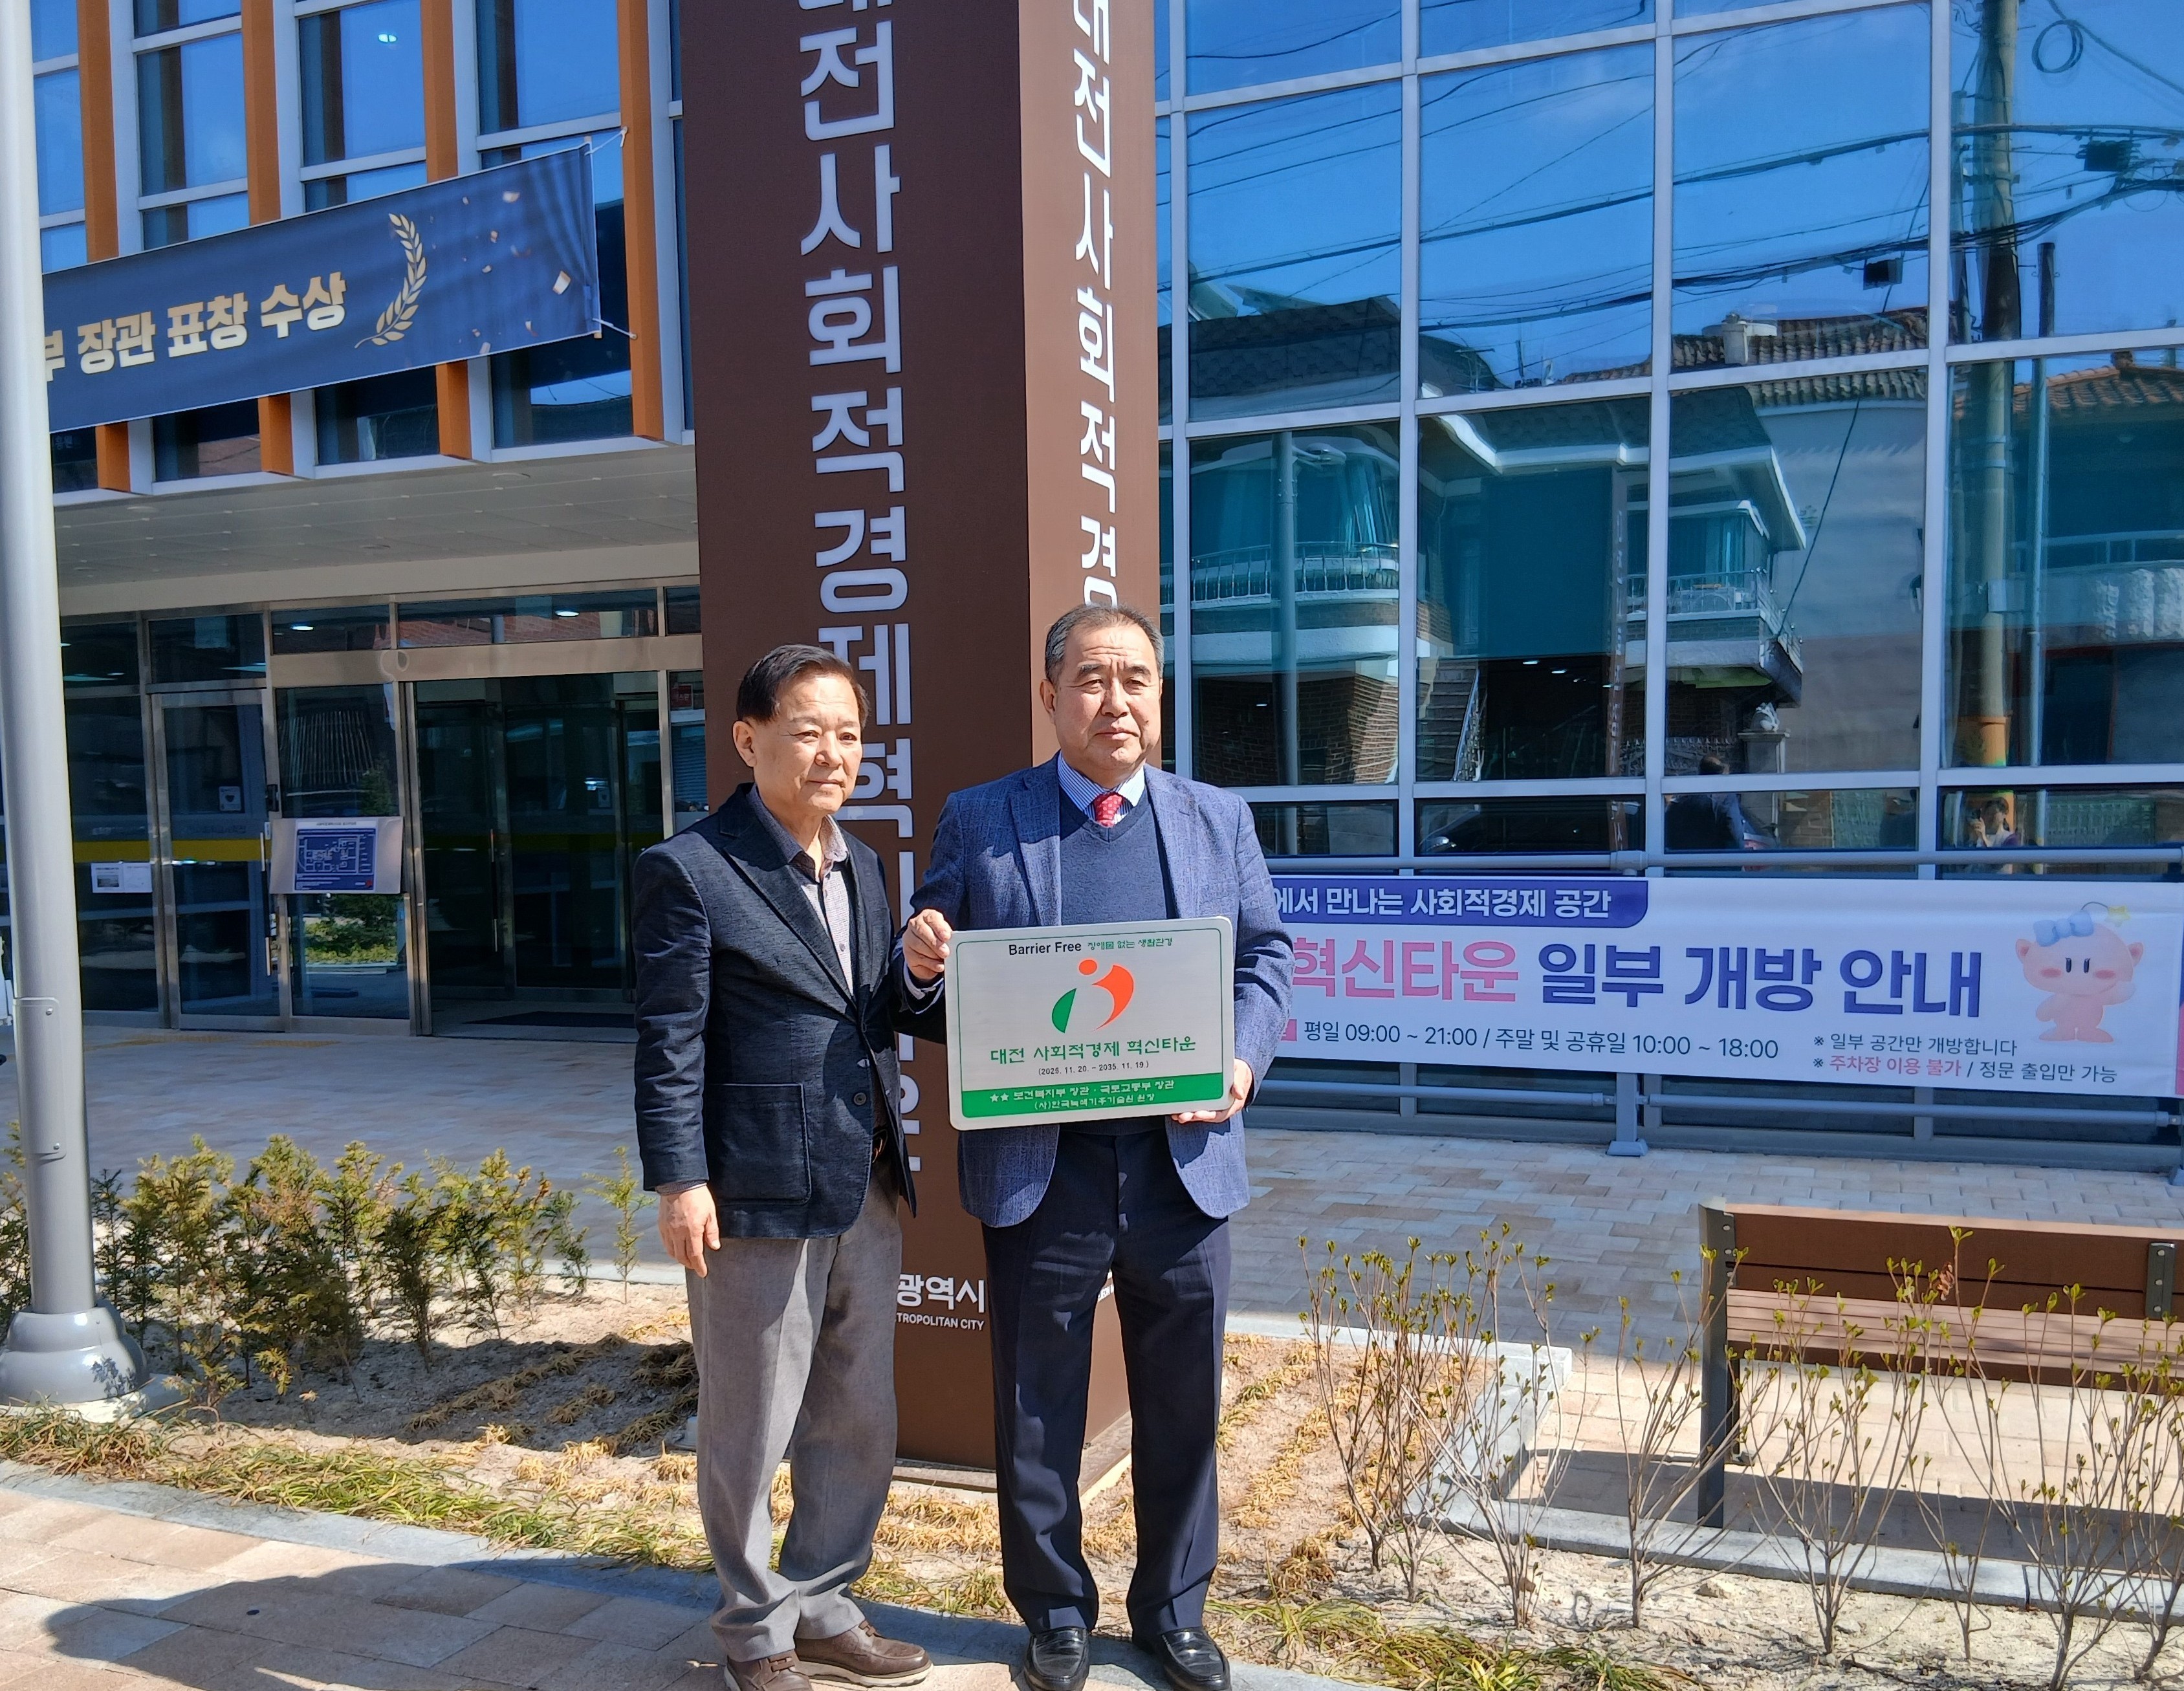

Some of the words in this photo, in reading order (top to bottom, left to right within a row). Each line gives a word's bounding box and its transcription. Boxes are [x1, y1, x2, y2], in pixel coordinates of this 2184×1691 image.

[78, 311, 156, 375] 장관
[167, 291, 248, 358] 표창
[260, 271, 347, 338] 수상
[1274, 887, 1318, 914] 에서
[1326, 888, 1403, 916] 만나는
[1411, 888, 1546, 917] 사회적경제
[1554, 890, 1612, 919] 공간
[1009, 943, 1051, 955] Barrier
[1055, 941, 1082, 953] Free
[1117, 940, 1135, 949] 없는
[1138, 937, 1173, 948] 생활환경
[1293, 937, 1518, 1002] 혁신타운
[1538, 943, 1663, 1007] 일부
[1685, 947, 1822, 1012] 개방
[1840, 950, 1982, 1018] 안내
[990, 1047, 1025, 1065] 대전
[1033, 1042, 1120, 1061] 사회적경제
[1127, 1036, 1196, 1054] 혁신타운
[1304, 1021, 1339, 1042] 평일
[1346, 1024, 1400, 1043] 09:00
[1425, 1027, 1477, 1045] 21:00
[1495, 1029, 1535, 1050] 주말
[1541, 1029, 1559, 1051] 및
[1566, 1031, 1626, 1054] 공휴일
[1633, 1035, 1690, 1054] 10:00
[1718, 1038, 1778, 1058] 18:00
[1830, 1033, 1864, 1051] 일부
[1870, 1034, 1921, 1053] 공간만
[1927, 1037, 2017, 1056] 개방합니다
[1829, 1055, 1881, 1073] 주차장
[1886, 1058, 1921, 1076] 이용
[1926, 1059, 1961, 1077] 불가
[1980, 1062, 2015, 1079] 정문
[2021, 1062, 2075, 1082] 출입만
[2081, 1065, 2117, 1084] 가능
[1013, 1088, 1066, 1100] 보건복지부
[1069, 1086, 1089, 1096] 장관
[1100, 1082, 1151, 1094] 국토교통부
[1155, 1080, 1174, 1089] 장관
[897, 1273, 985, 1313] 광역시
[960, 1318, 985, 1331] CITY
